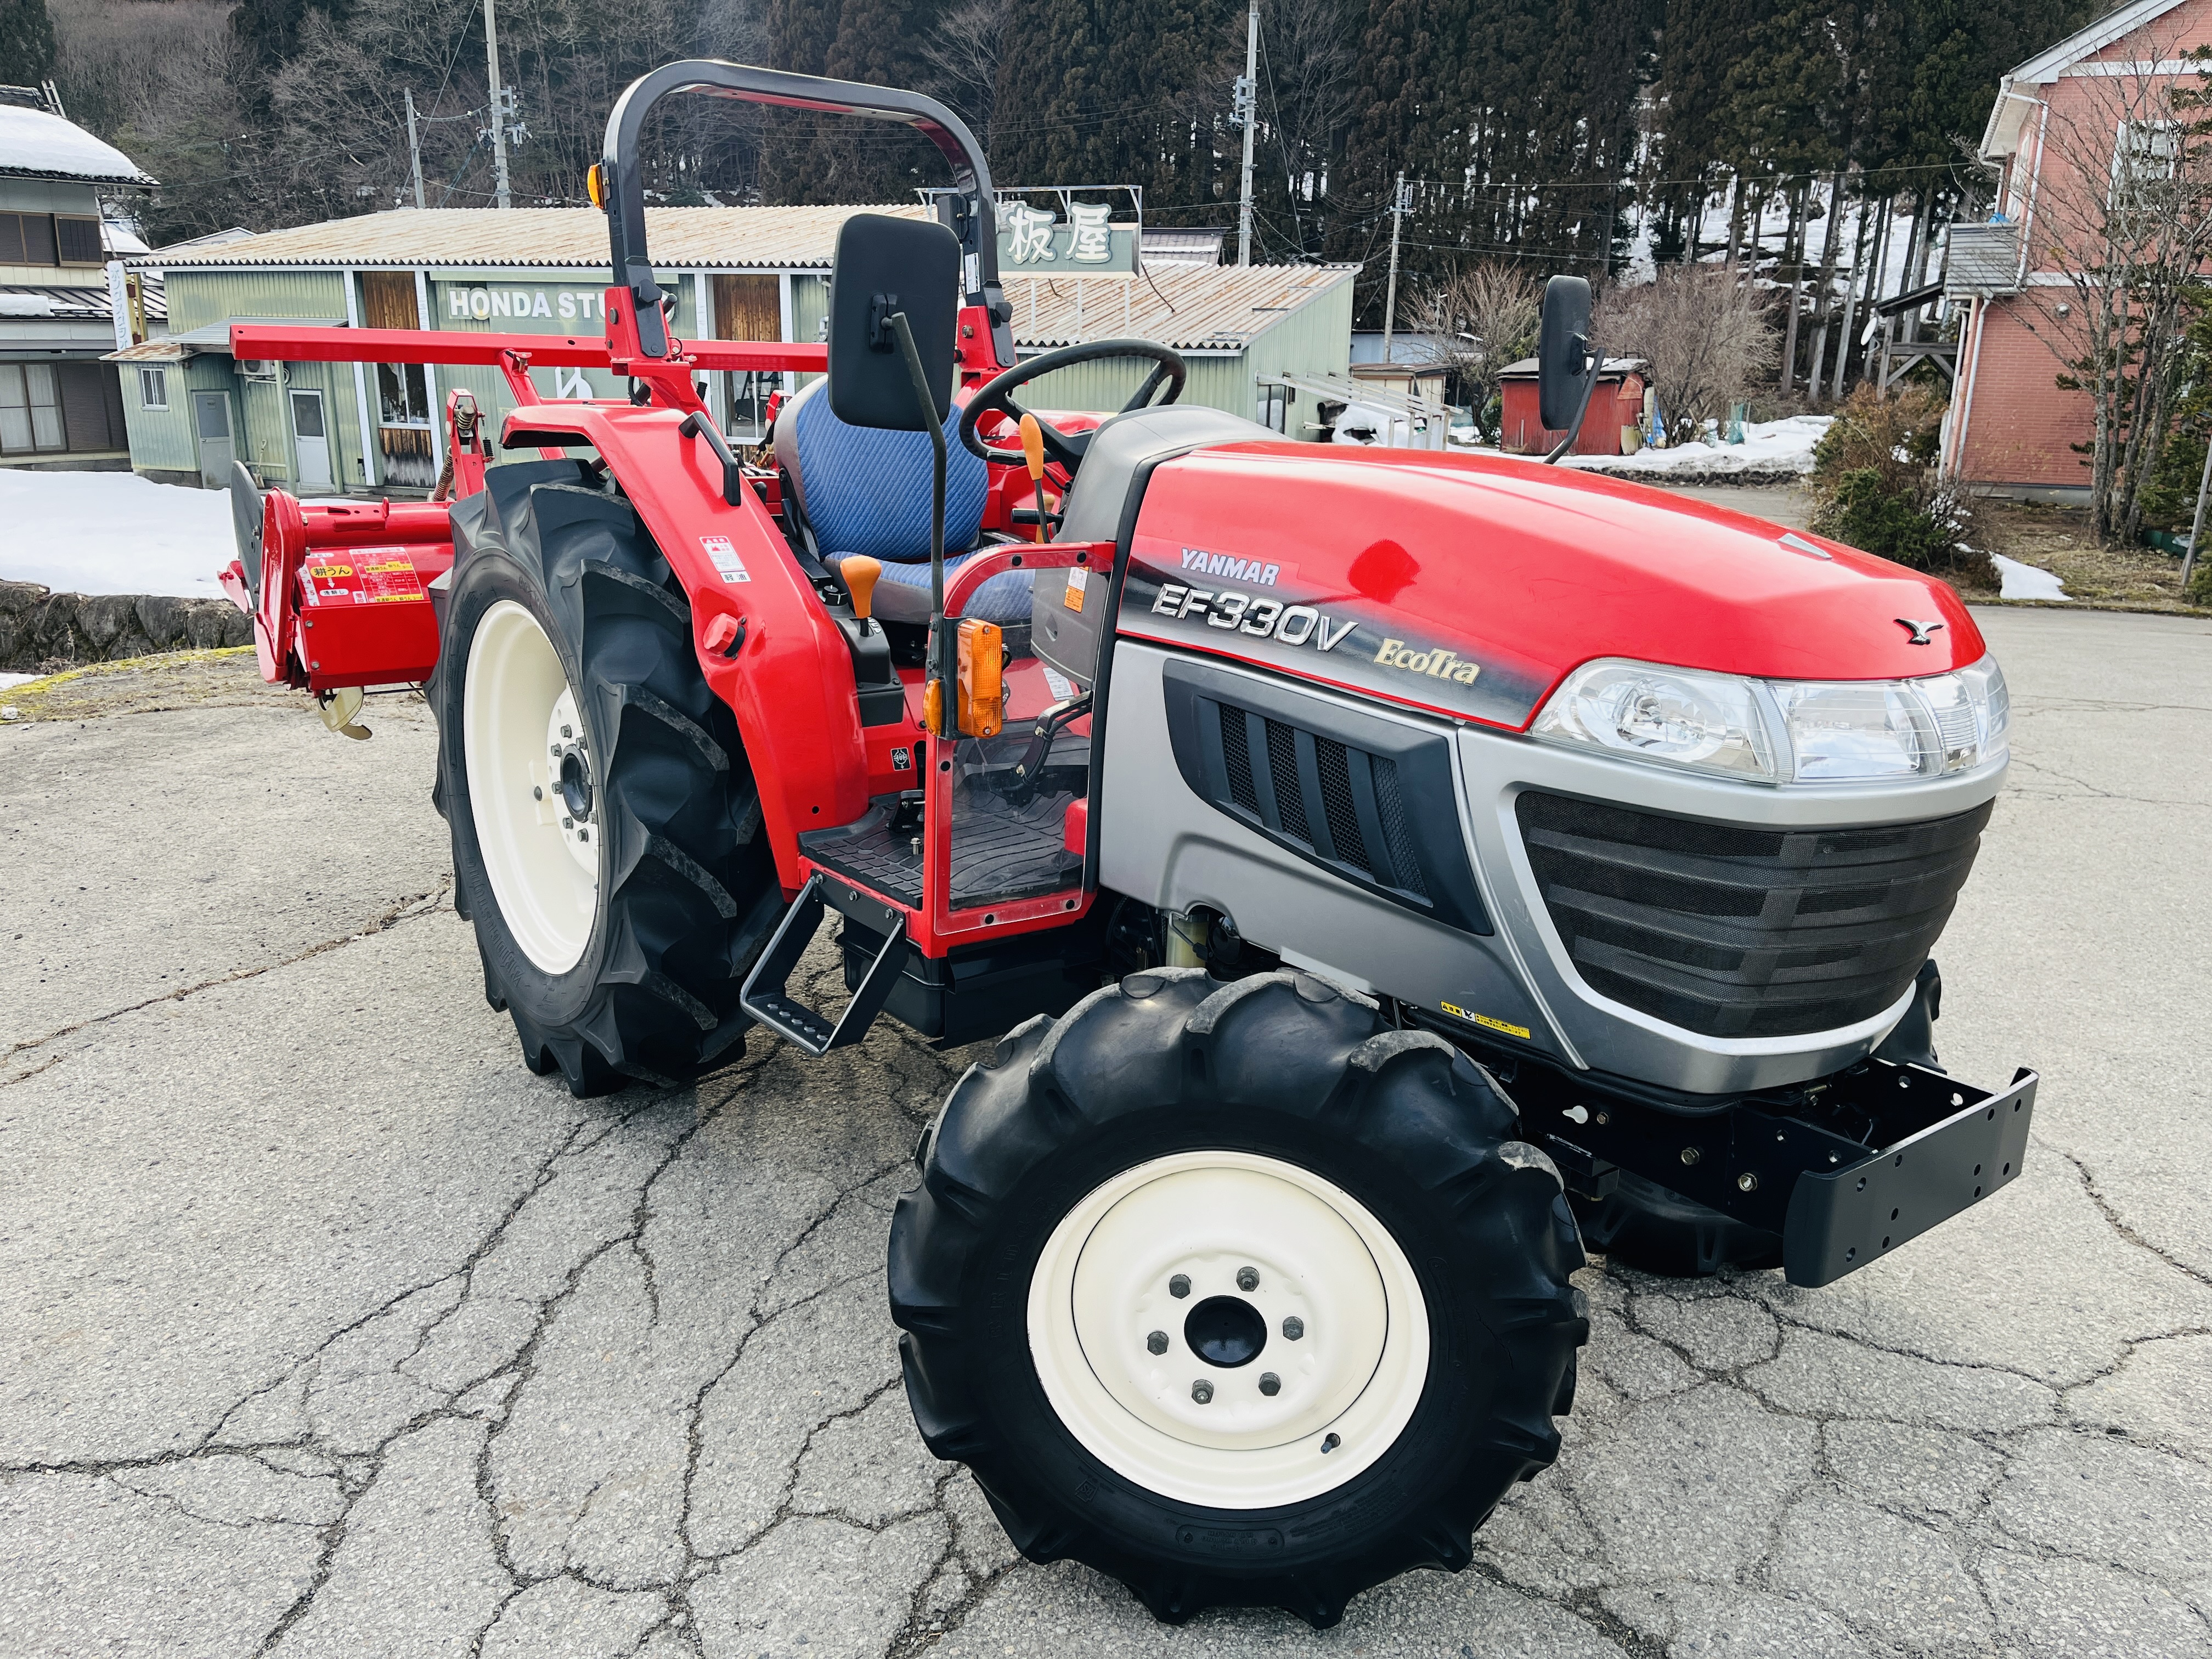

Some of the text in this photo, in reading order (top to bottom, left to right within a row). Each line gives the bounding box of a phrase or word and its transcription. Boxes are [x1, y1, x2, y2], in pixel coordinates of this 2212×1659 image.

[449, 290, 553, 318] HONDA
[314, 567, 350, 576] 耕うん
[1181, 548, 1280, 586] YANMAR
[1150, 583, 1359, 652] EF330V
[1373, 637, 1482, 687] EcoTra
